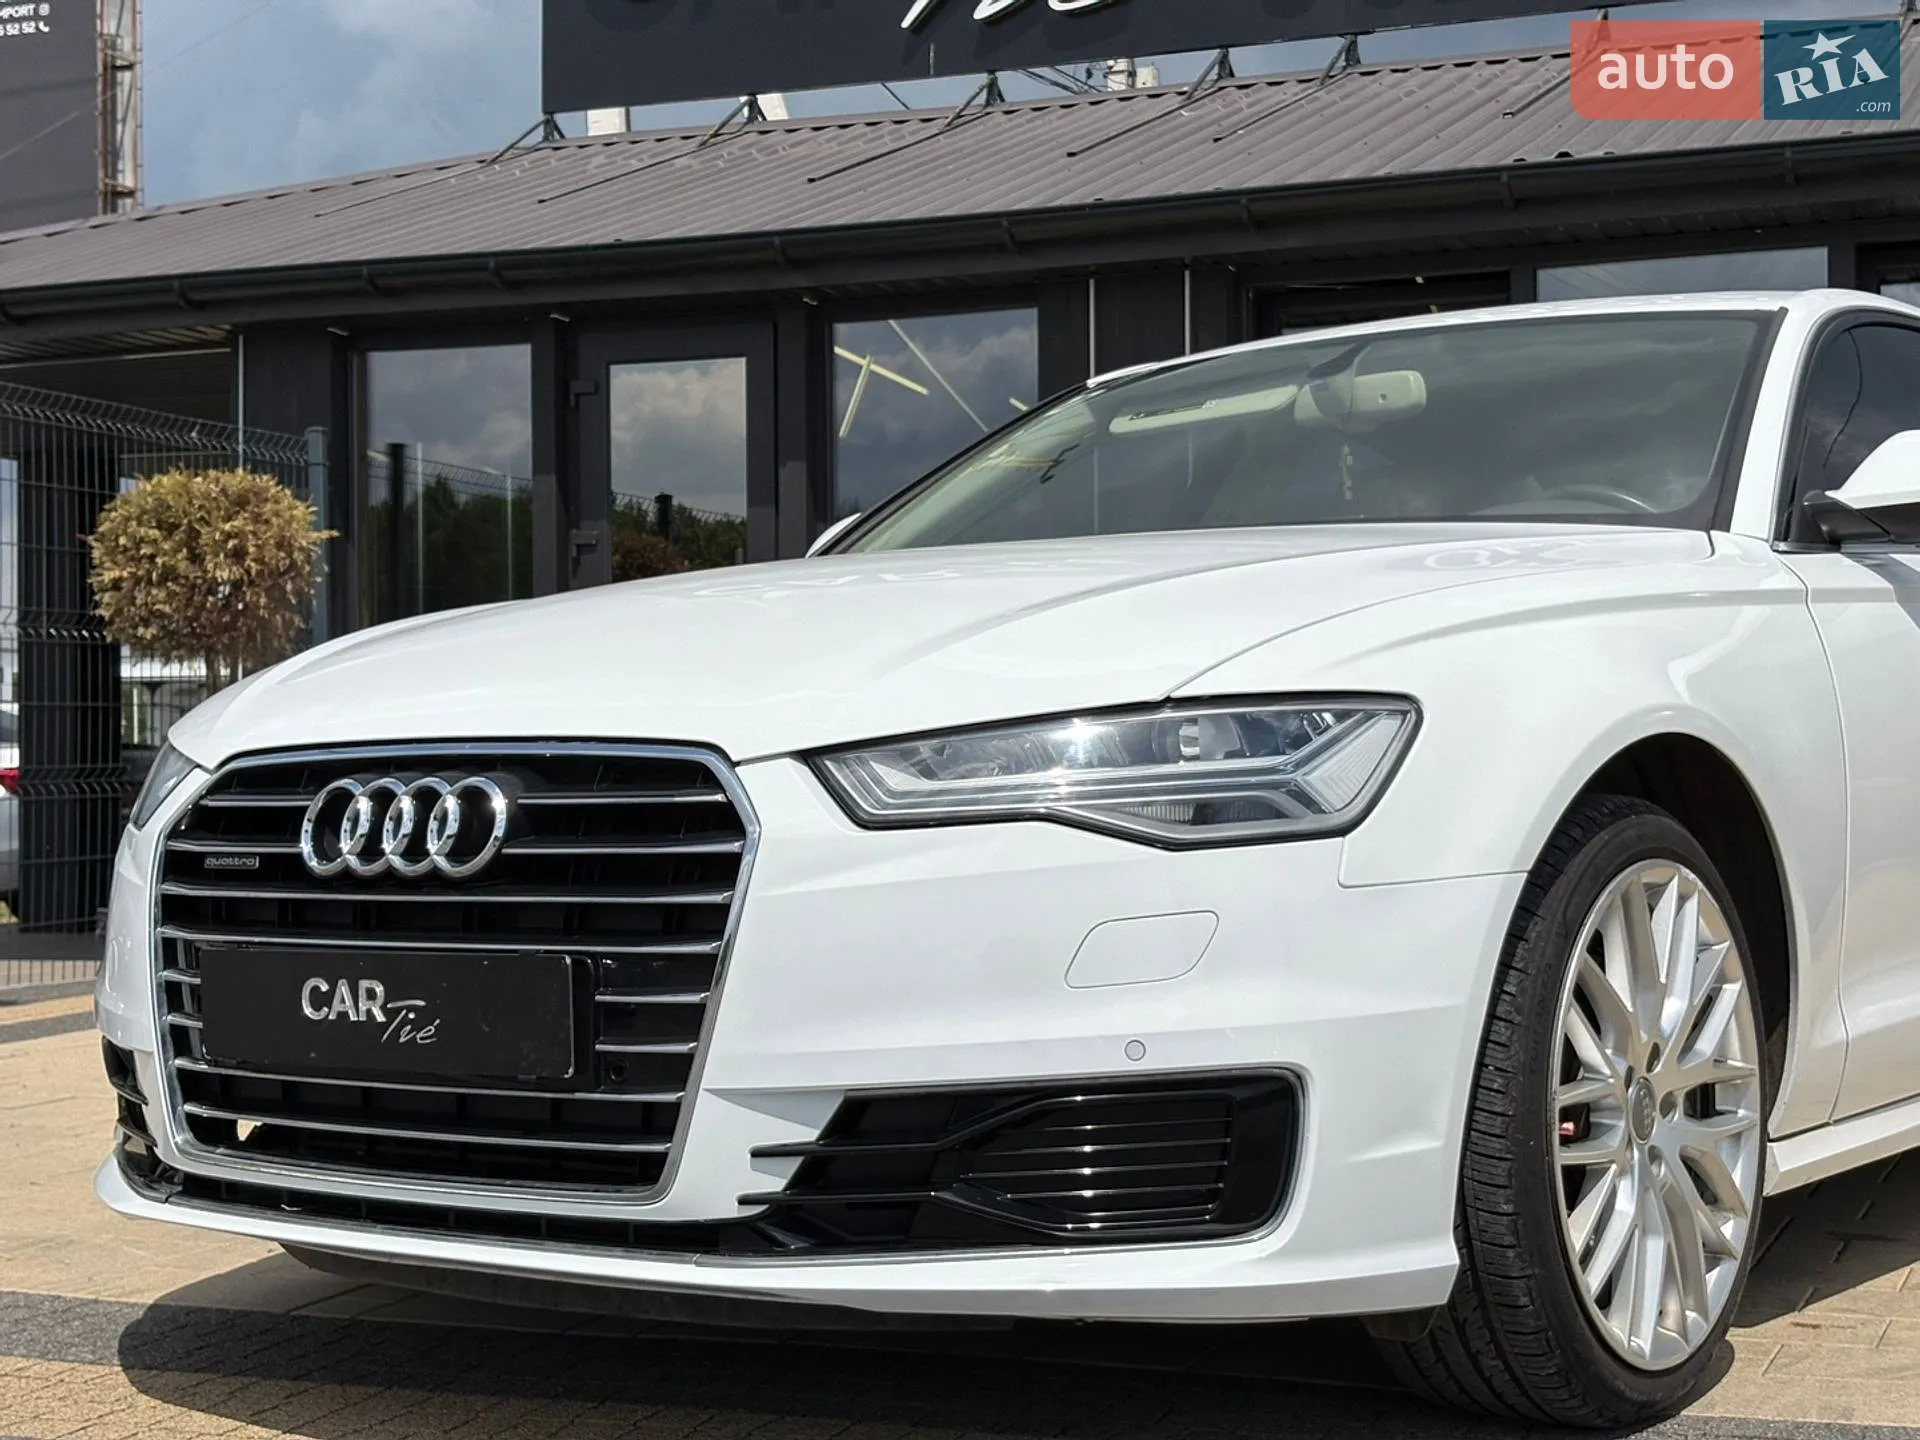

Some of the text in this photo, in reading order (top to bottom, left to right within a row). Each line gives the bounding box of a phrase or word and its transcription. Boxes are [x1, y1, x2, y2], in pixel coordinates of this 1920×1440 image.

[21, 21, 36, 34] 52
[206, 855, 255, 867] quattro
[301, 976, 387, 1022] CAR
